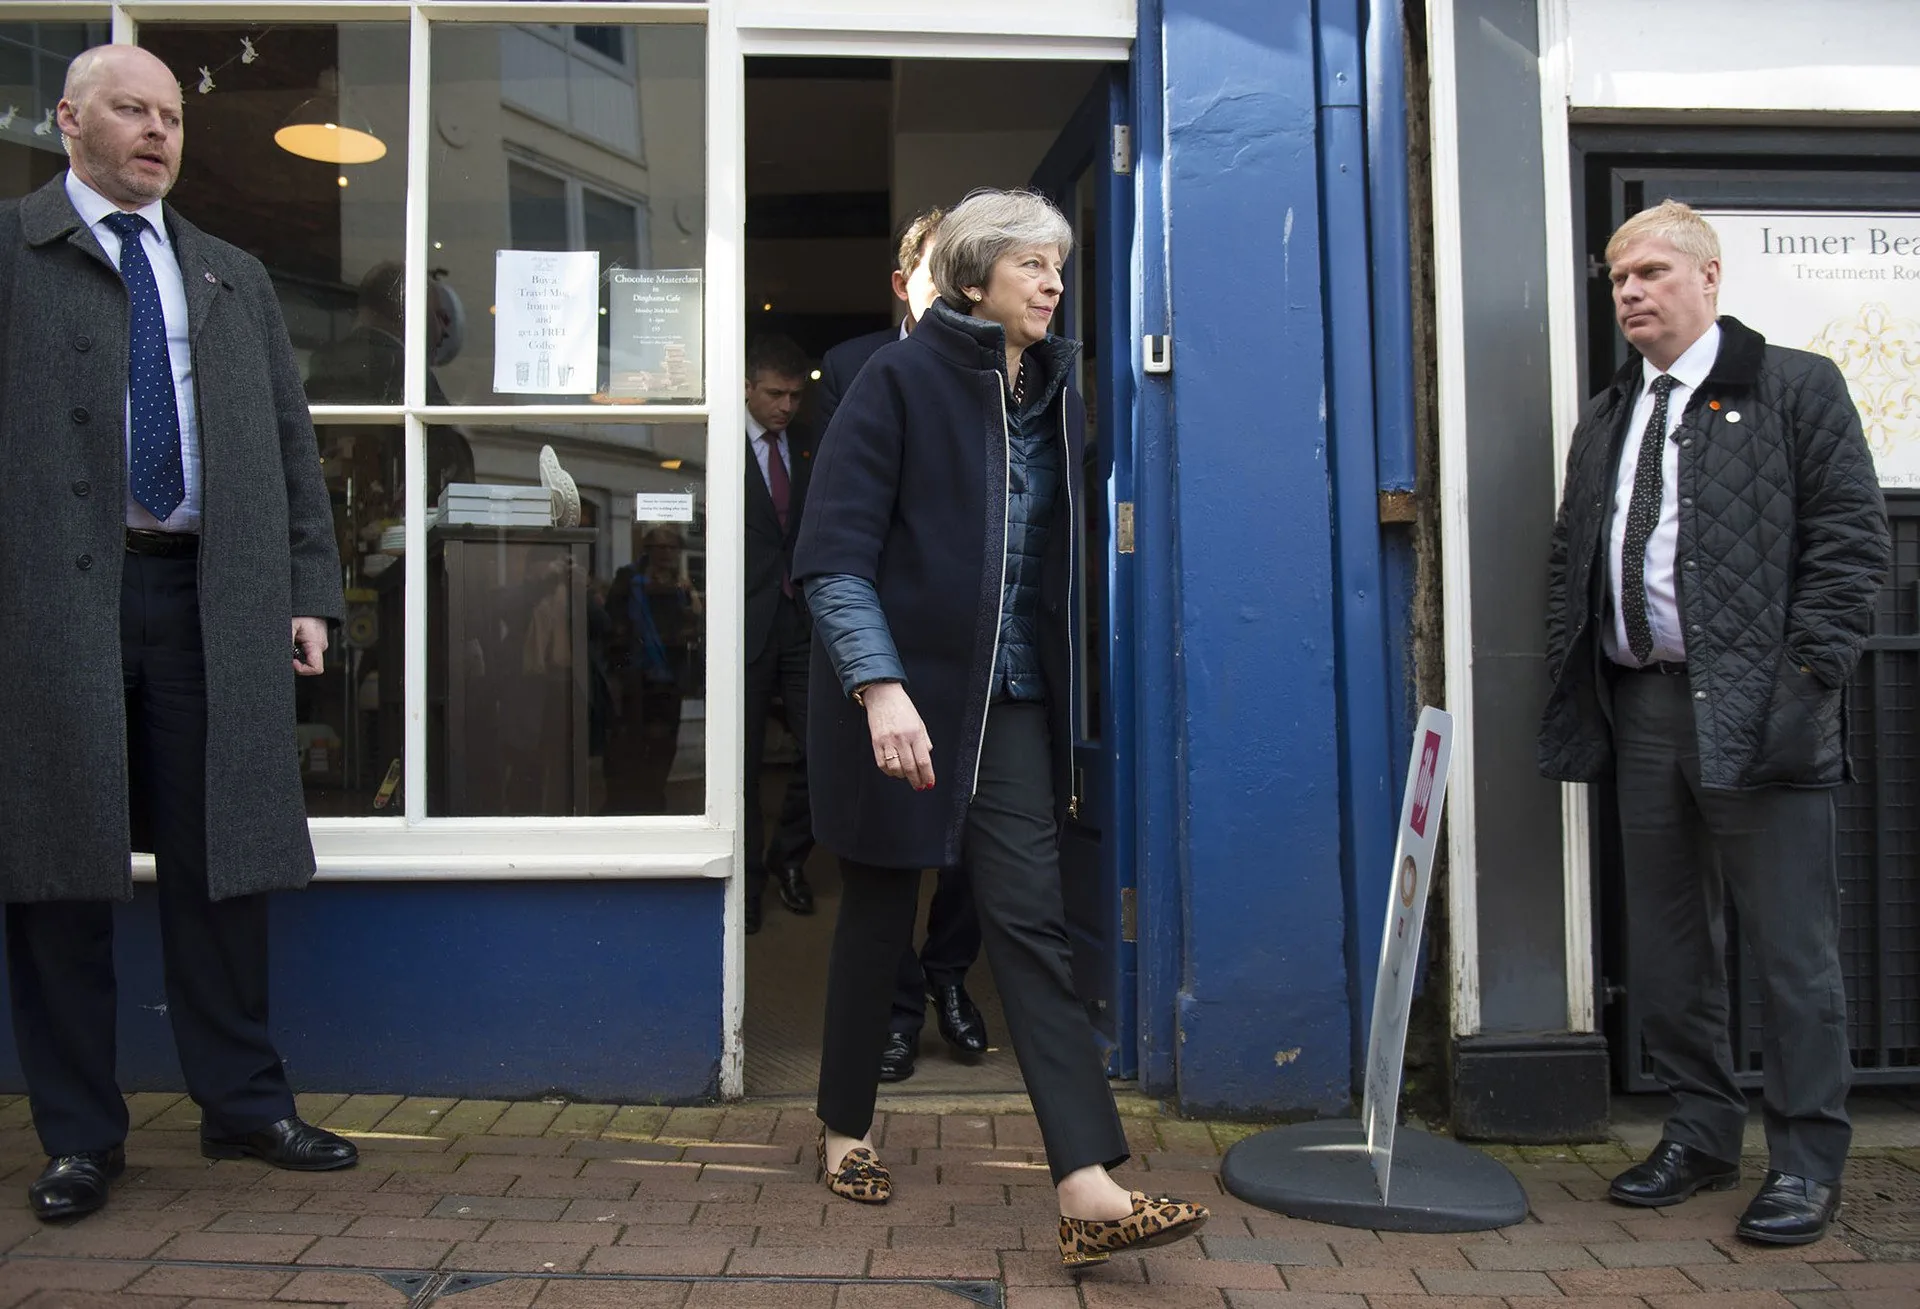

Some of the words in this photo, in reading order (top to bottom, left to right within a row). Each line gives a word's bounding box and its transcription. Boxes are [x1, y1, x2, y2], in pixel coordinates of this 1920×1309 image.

[1761, 227, 1855, 255] Inner
[1793, 264, 1887, 280] Treatment
[614, 274, 654, 284] Chocolate
[656, 274, 698, 284] Masterclass
[519, 287, 547, 297] Travel
[526, 301, 548, 310] from
[535, 314, 552, 324] and
